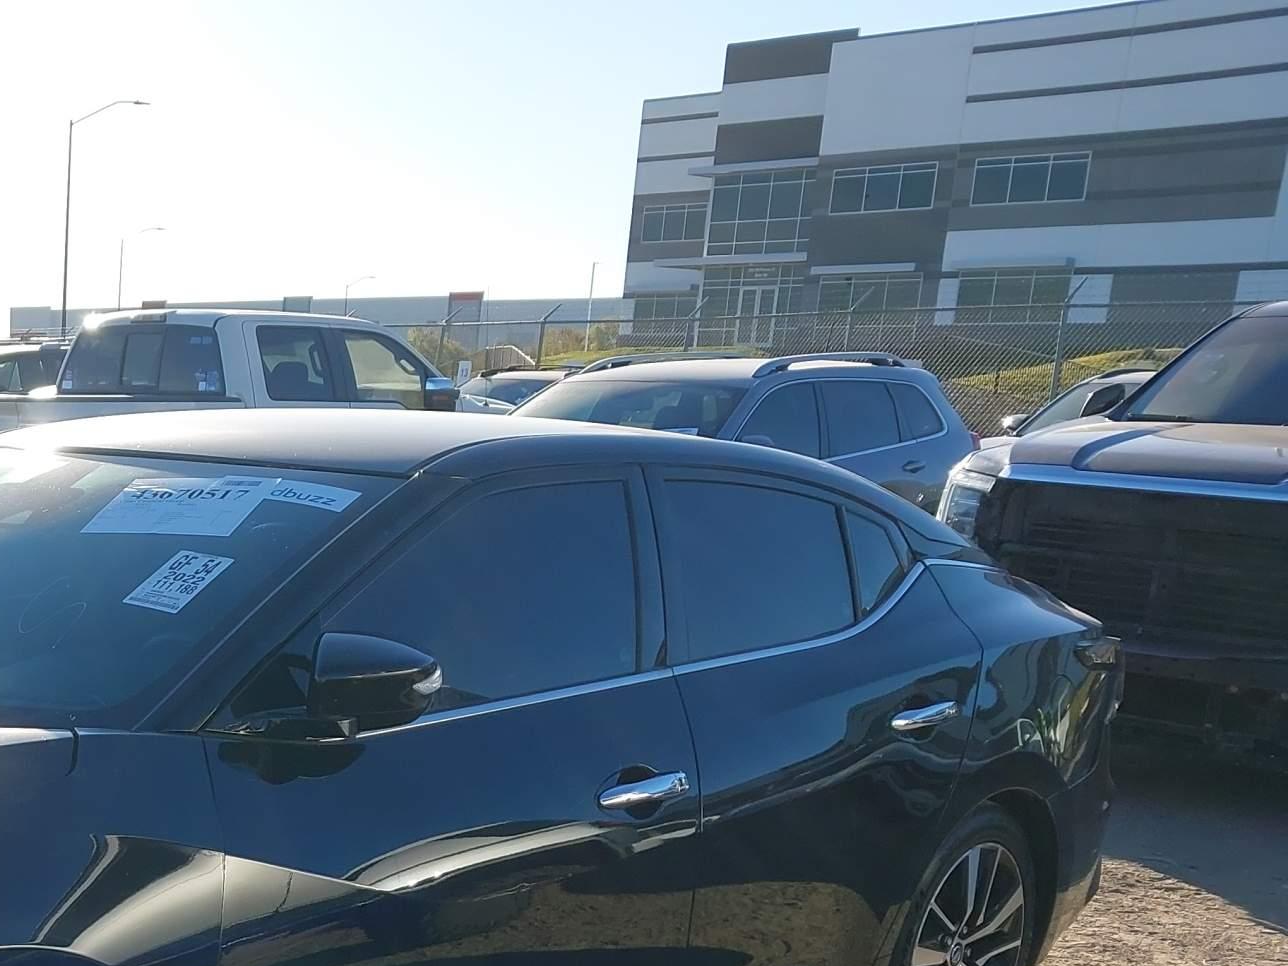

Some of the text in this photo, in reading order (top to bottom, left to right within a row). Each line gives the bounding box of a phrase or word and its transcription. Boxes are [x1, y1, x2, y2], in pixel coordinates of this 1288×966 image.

[131, 489, 250, 500] 43670517
[270, 486, 337, 506] dbuzz
[169, 554, 222, 577] GF 54
[164, 571, 206, 586] 2022
[152, 579, 198, 596] 111,188
